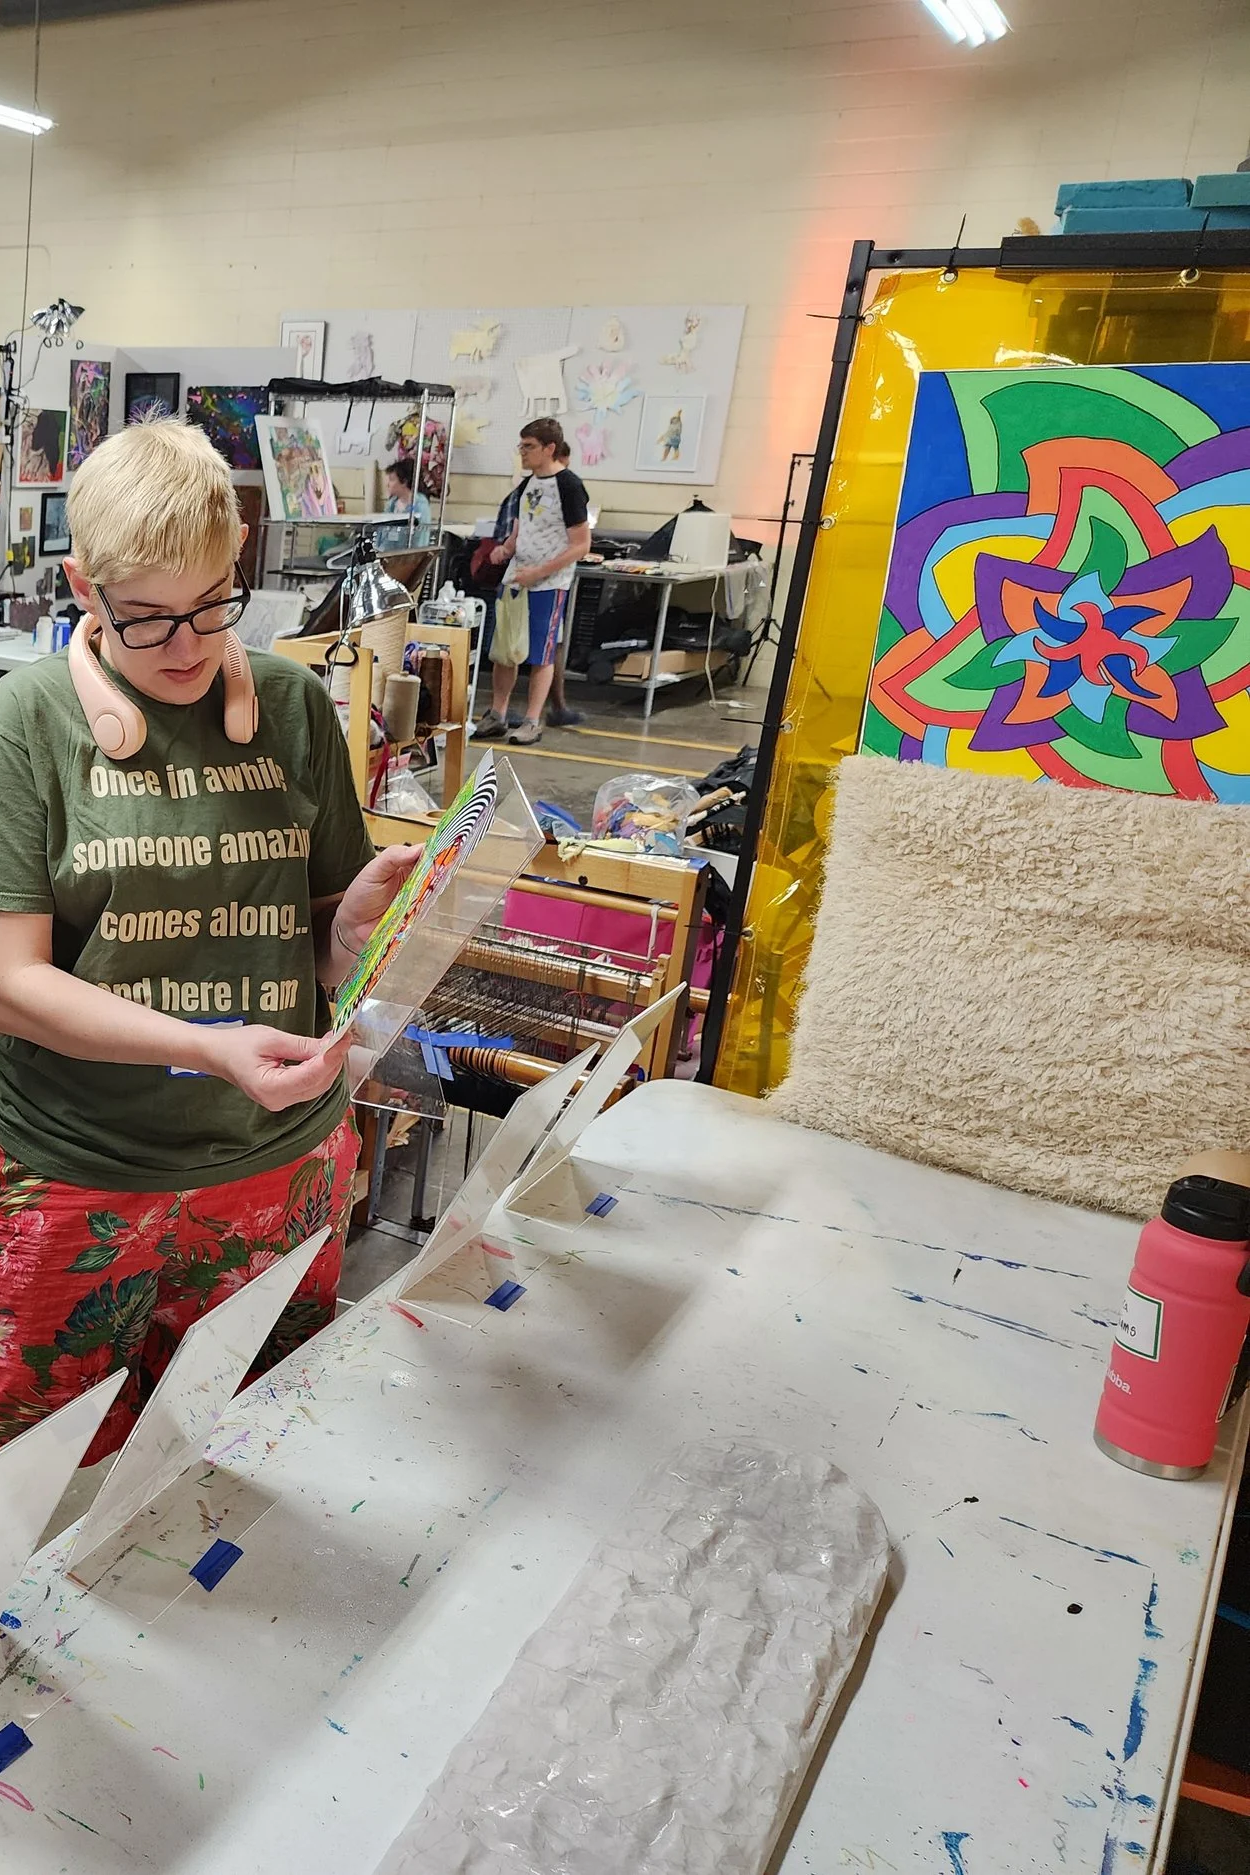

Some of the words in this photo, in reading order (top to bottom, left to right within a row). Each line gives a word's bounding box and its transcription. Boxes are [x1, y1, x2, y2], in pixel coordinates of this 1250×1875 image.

[90, 765, 162, 798] Once
[165, 763, 198, 799] in
[72, 834, 212, 875] someone
[100, 908, 202, 943] comes
[161, 977, 232, 1012] here
[241, 976, 250, 1012] I
[259, 978, 299, 1012] am
